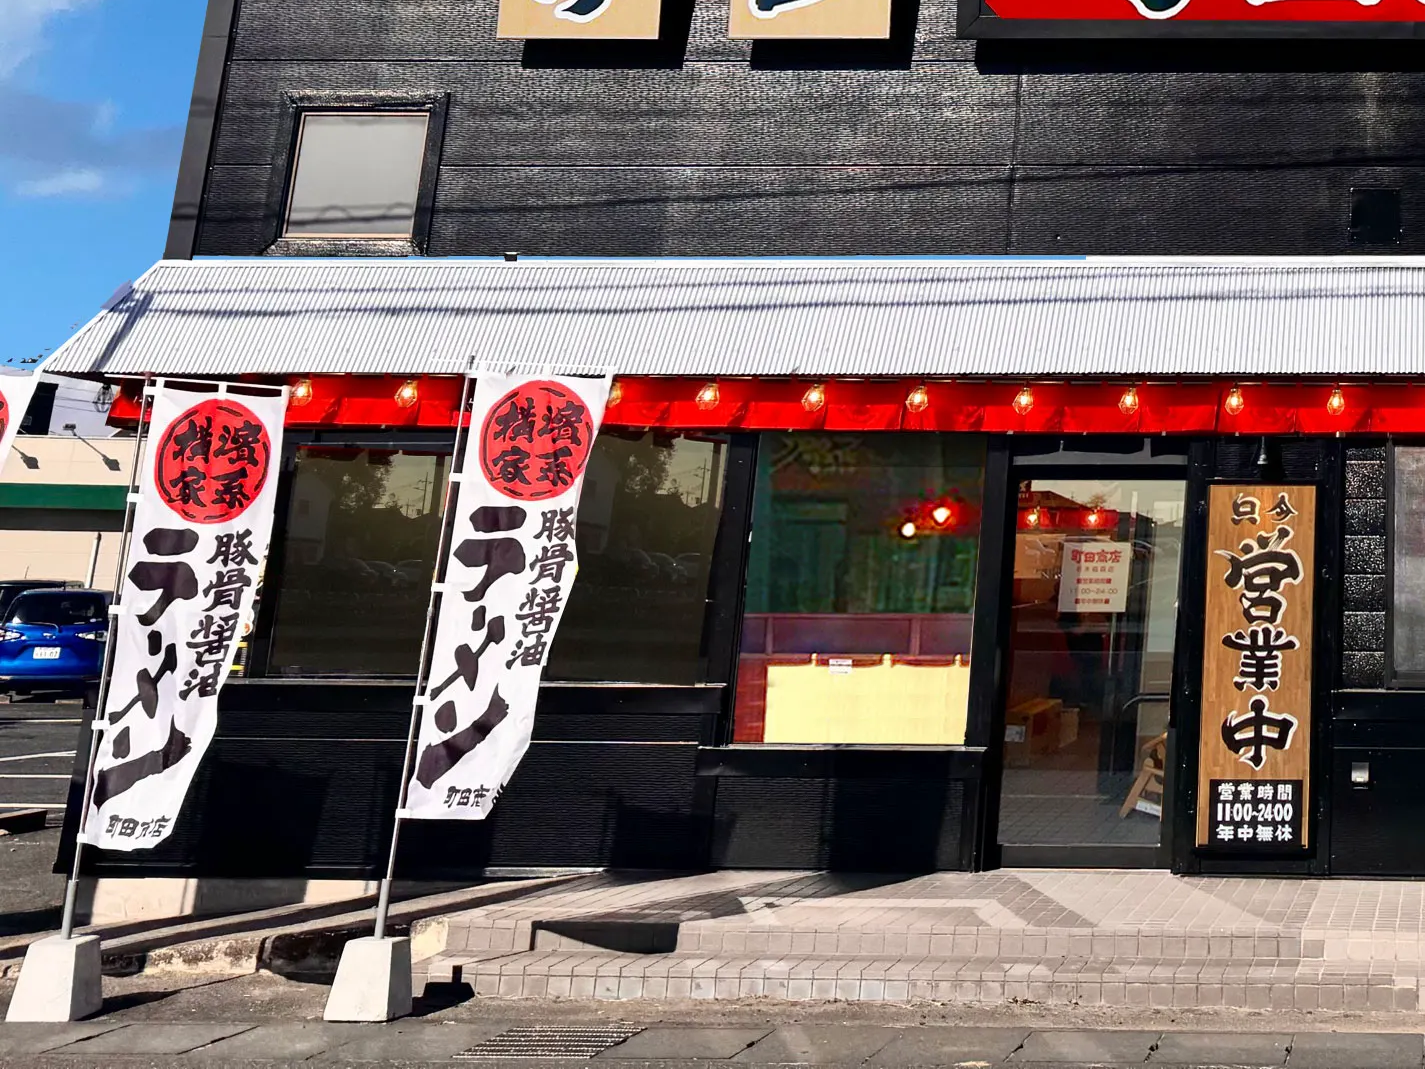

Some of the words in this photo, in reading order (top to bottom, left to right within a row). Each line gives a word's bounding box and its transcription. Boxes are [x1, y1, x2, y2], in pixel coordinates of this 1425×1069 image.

[93, 528, 200, 808] ラーメン
[416, 505, 527, 789] ラーメン
[1214, 525, 1304, 771] 営業中
[1216, 824, 1293, 842] 年中無休
[1218, 782, 1293, 801] 営業時間
